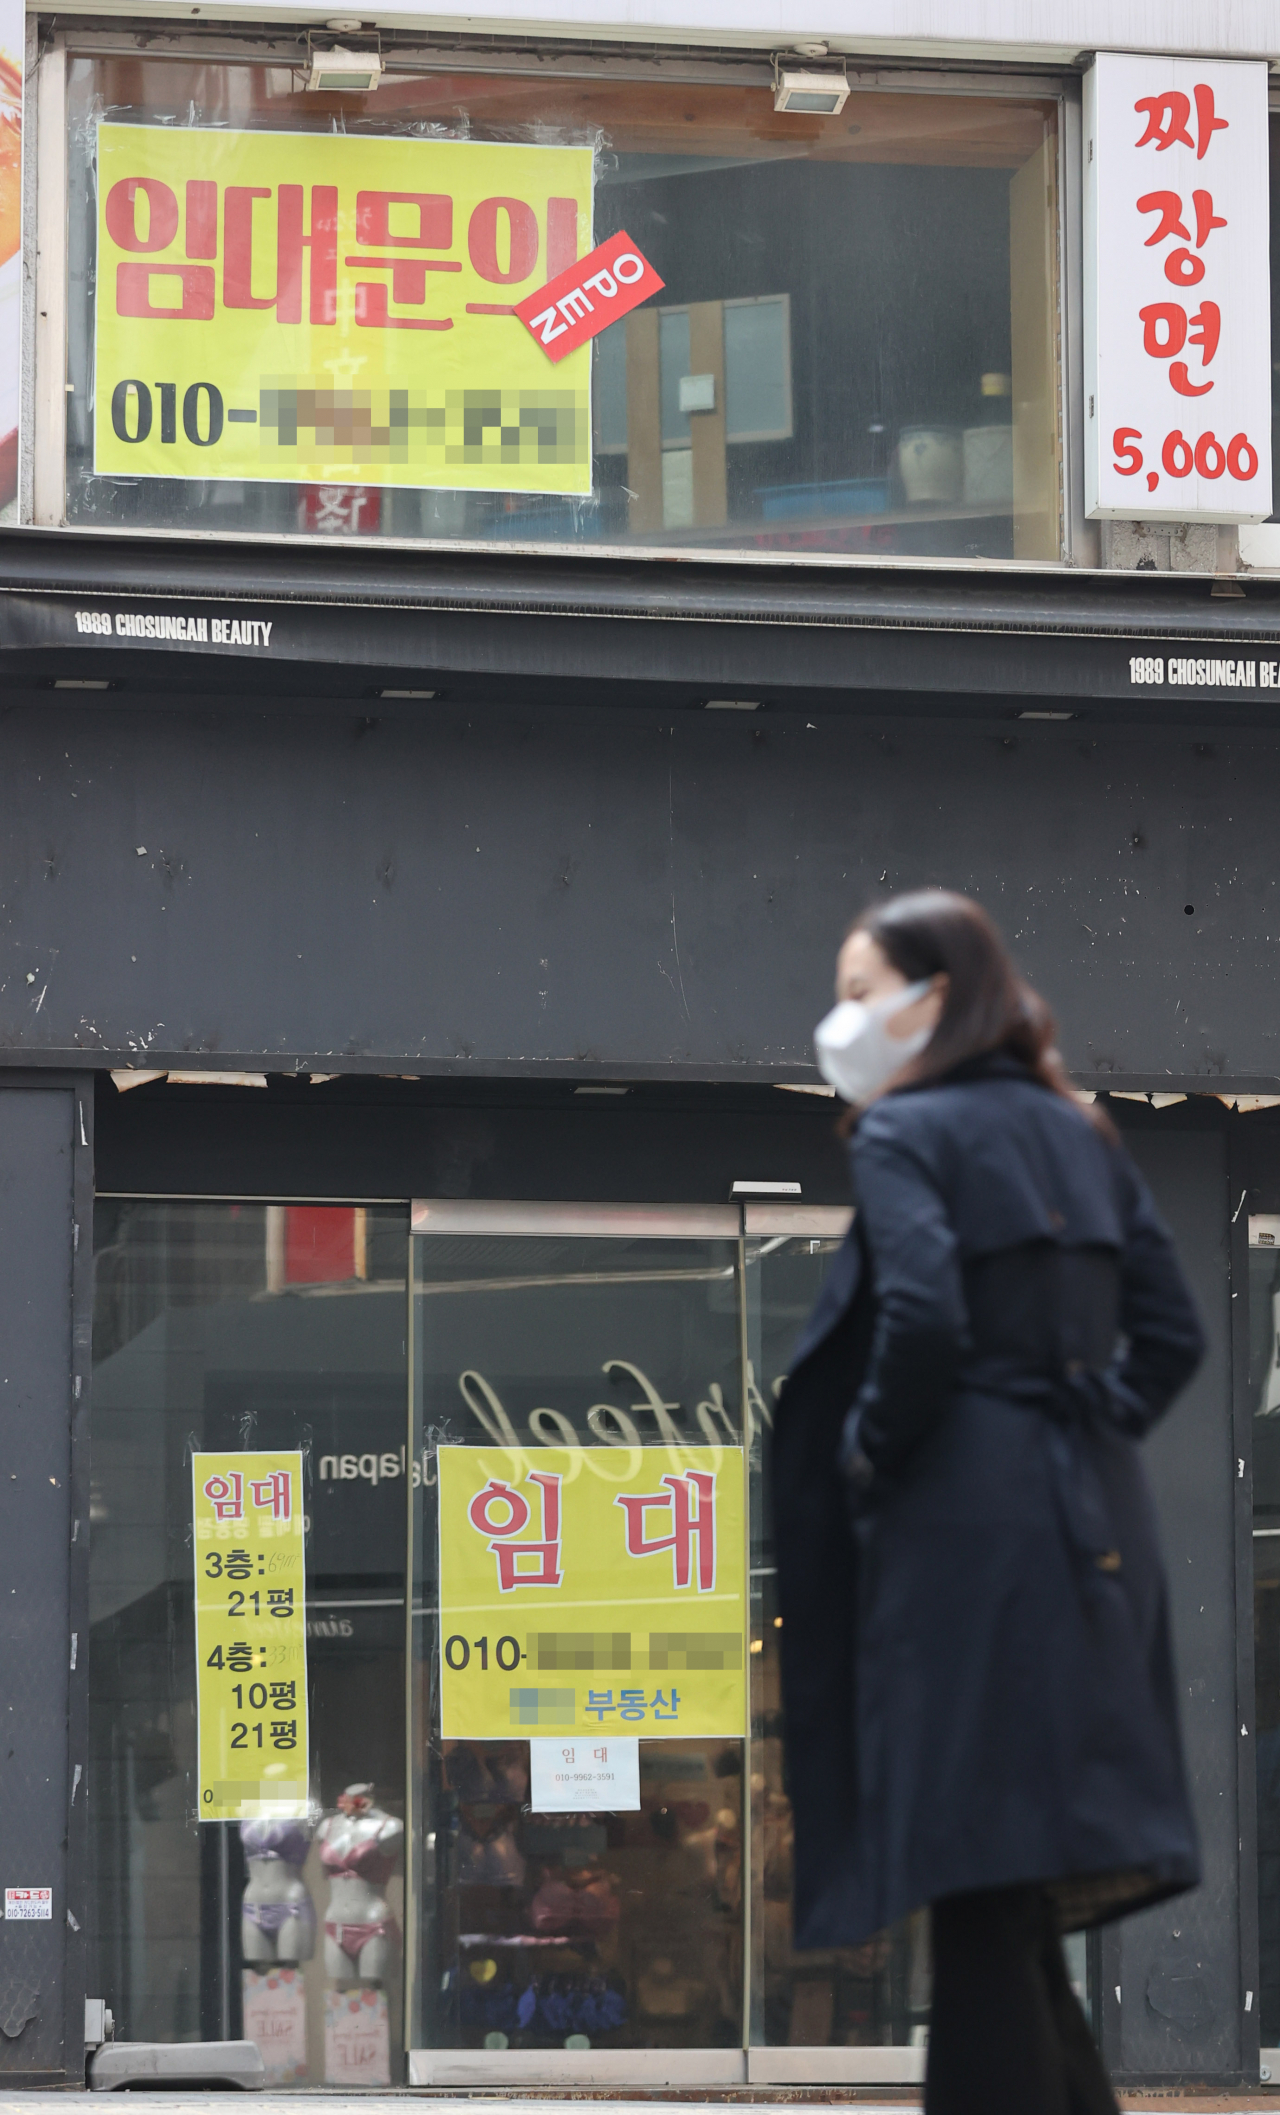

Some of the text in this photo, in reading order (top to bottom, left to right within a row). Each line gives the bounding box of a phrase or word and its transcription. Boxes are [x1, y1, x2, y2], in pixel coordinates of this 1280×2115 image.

[105, 176, 579, 331] 임대문의
[1133, 83, 1229, 398] 짜장면
[528, 253, 645, 346] OPEN
[1112, 427, 1259, 493] 5,000
[75, 611, 272, 646] 1989 CHOSUNGAH BEAUTY
[1129, 657, 1280, 688] 1989 CHOSUNGAH BE
[203, 1470, 293, 1522] 임대
[205, 1549, 265, 1580] 3층:
[227, 1588, 294, 1618] 21평
[207, 1642, 267, 1672] 4층:
[231, 1680, 297, 1711] 10평
[584, 1688, 681, 1722] 부동산
[230, 1719, 298, 1750] 21평
[555, 1773, 615, 1782] 010-9962-3591
